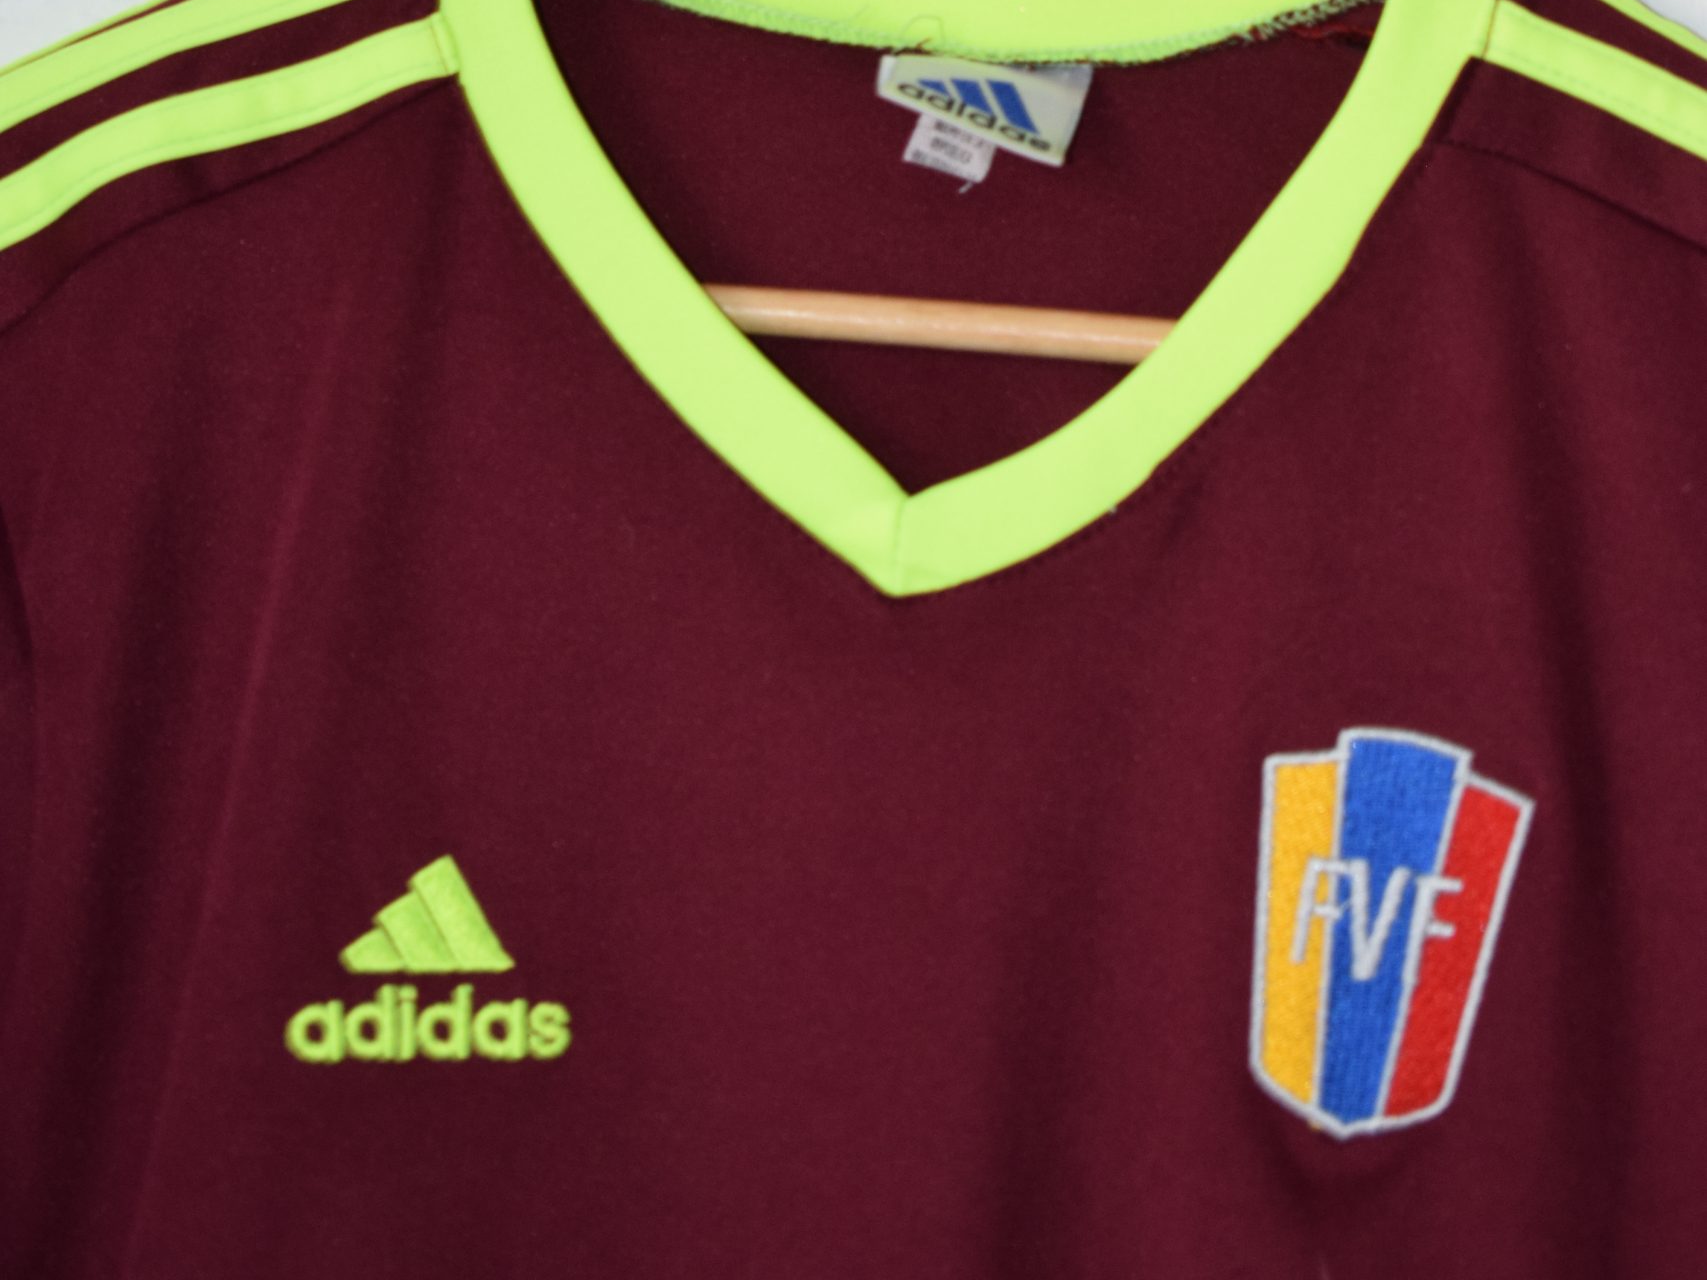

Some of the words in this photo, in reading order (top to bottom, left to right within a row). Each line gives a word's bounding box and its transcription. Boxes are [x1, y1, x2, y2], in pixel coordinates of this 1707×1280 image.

[897, 82, 1052, 151] adidas
[1290, 857, 1465, 984] FVF
[284, 982, 573, 1065] adidas
